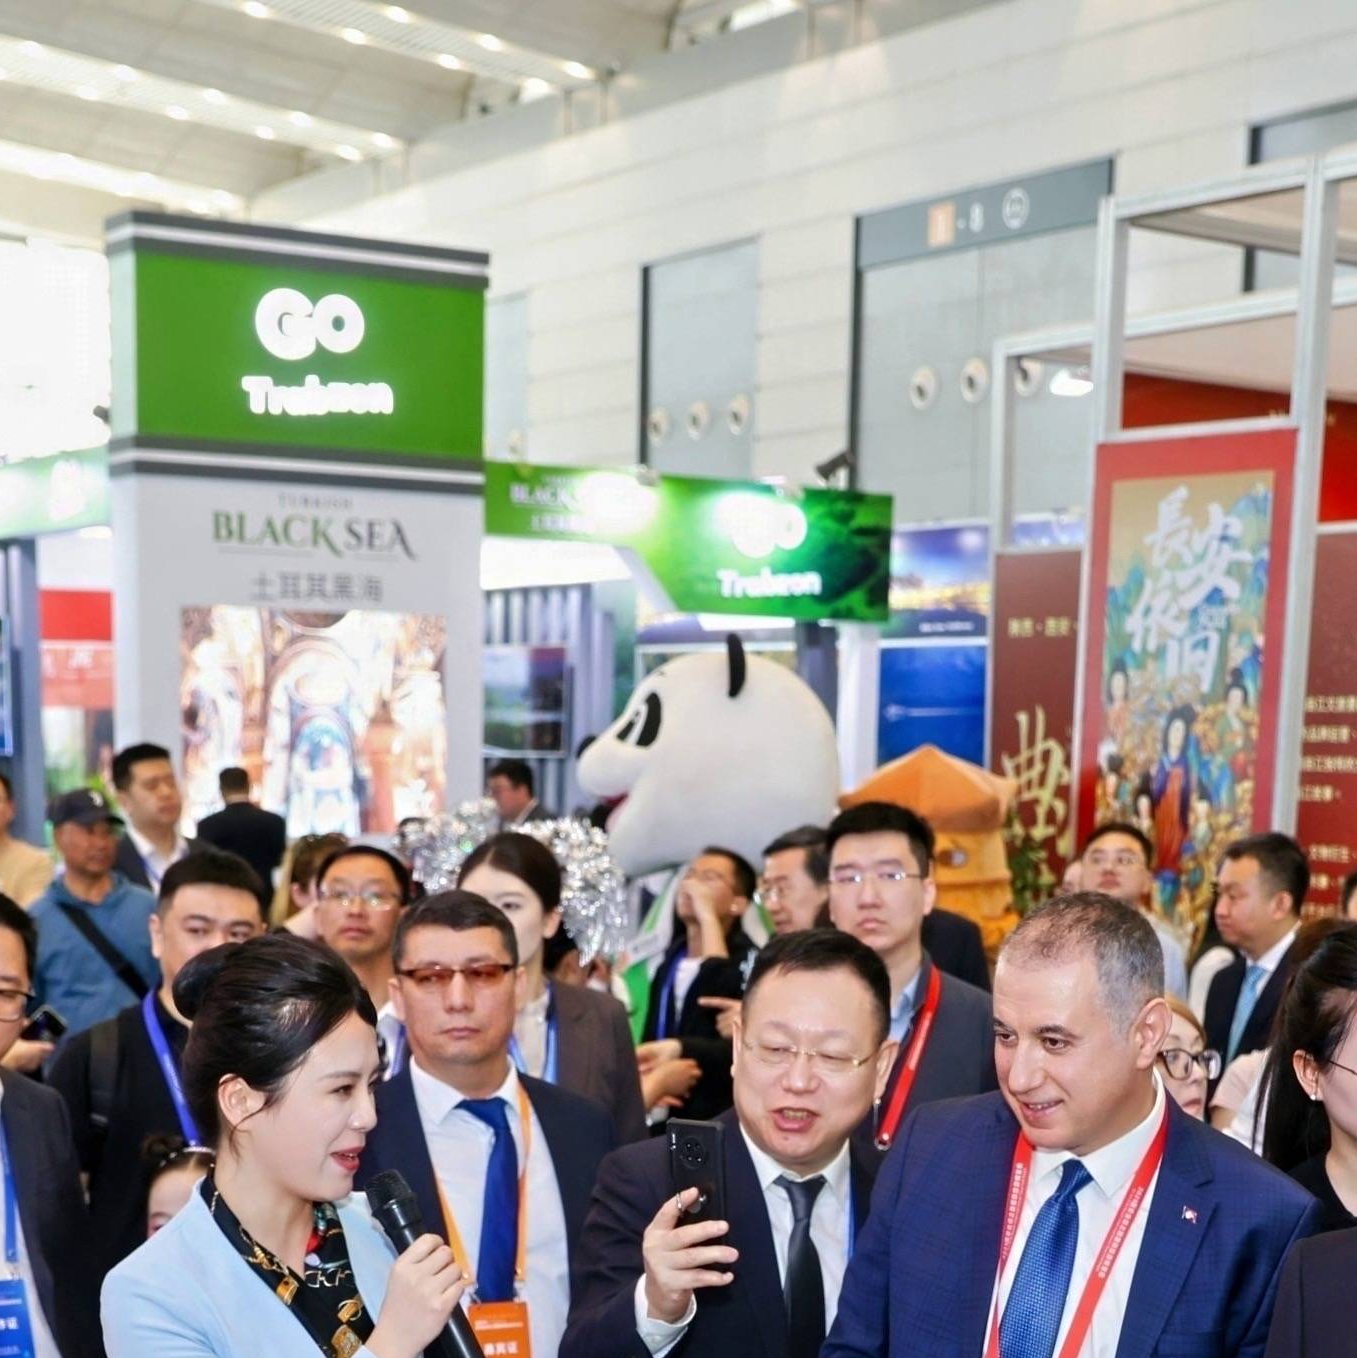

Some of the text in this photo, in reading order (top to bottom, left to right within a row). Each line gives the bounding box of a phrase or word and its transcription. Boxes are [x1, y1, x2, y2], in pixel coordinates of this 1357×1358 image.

[255, 288, 365, 360] GO
[212, 510, 418, 561] BLACK SEA
[252, 572, 384, 602] 土耳其黑海
